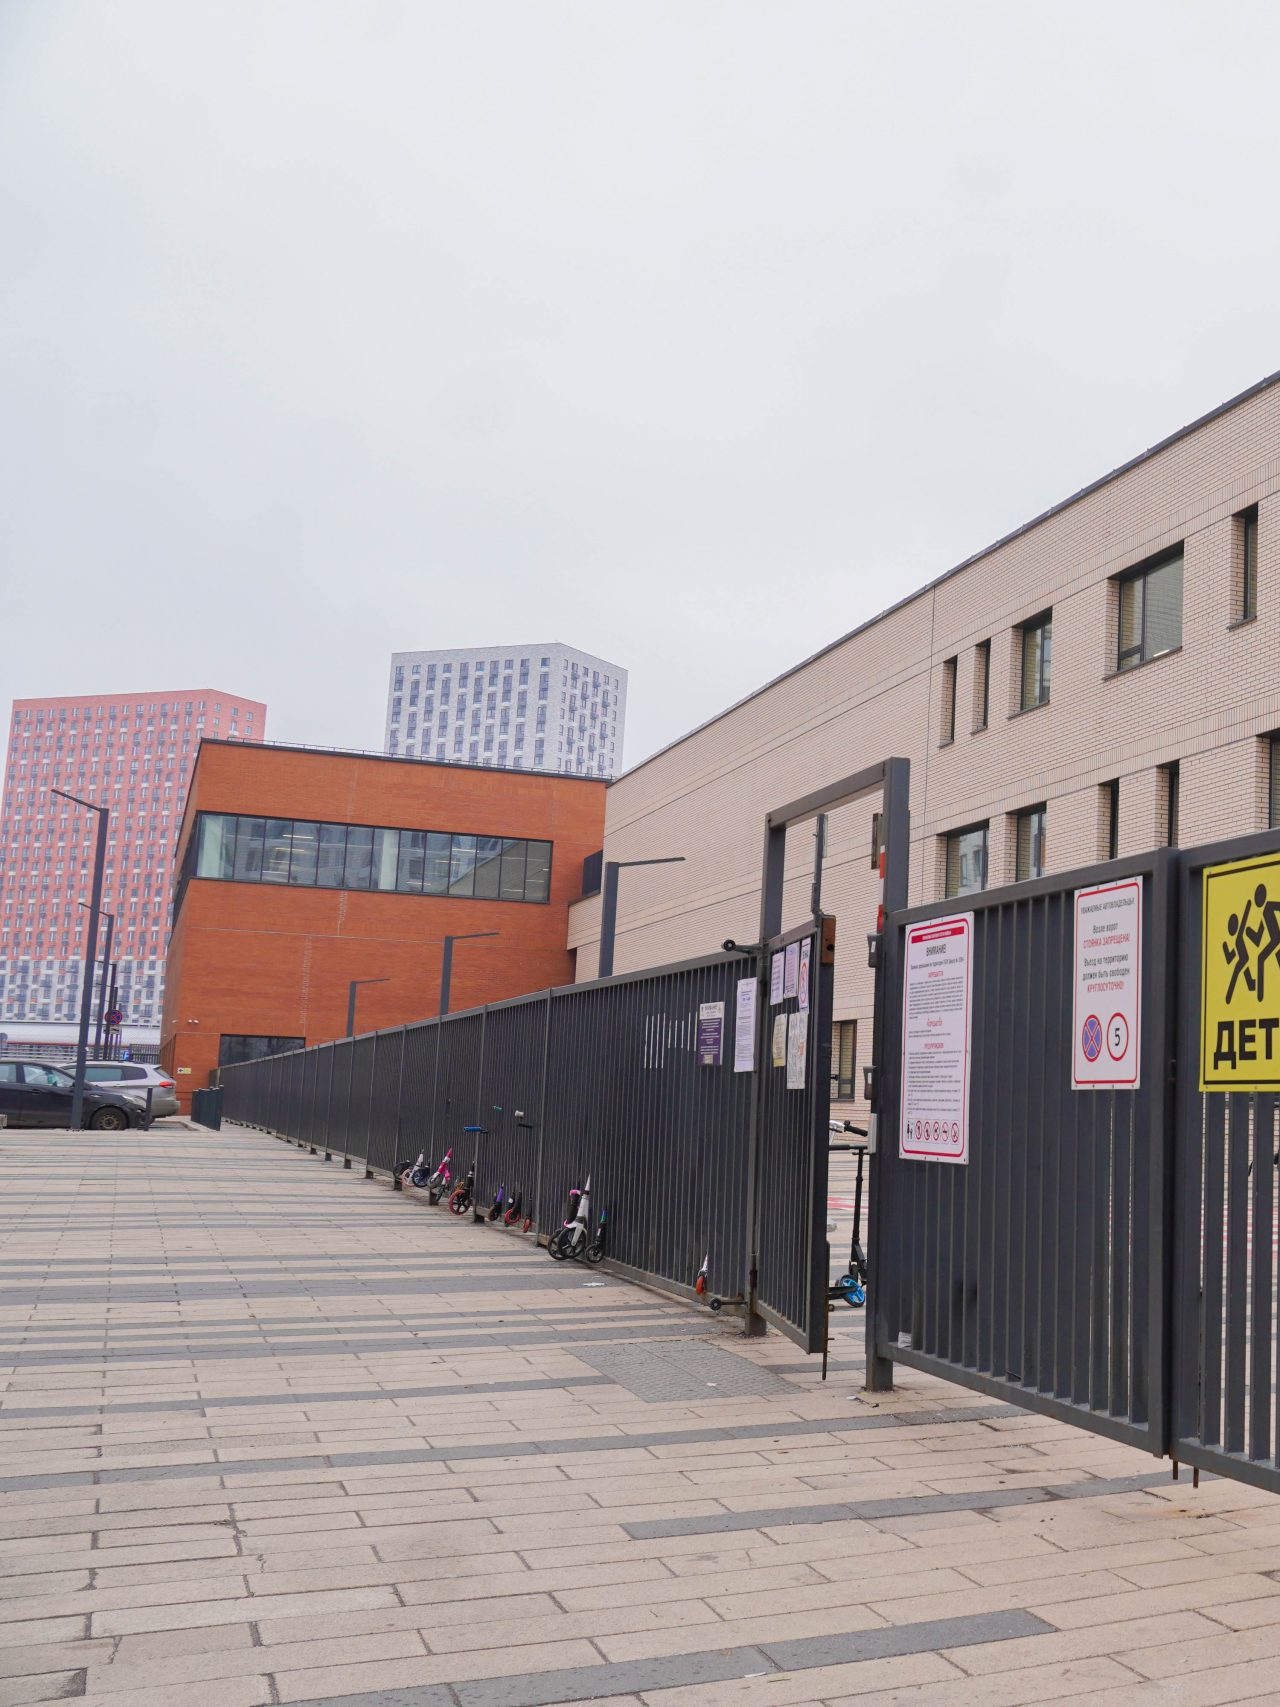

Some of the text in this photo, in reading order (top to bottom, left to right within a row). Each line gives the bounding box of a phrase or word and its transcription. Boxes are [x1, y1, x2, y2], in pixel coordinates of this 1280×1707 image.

[1083, 937, 1101, 949] СТОЯНКА
[1084, 958, 1096, 967] Въезд
[1103, 955, 1129, 966] территорию
[1082, 968, 1130, 982] должен быть свободен
[1115, 1027, 1121, 1047] 5
